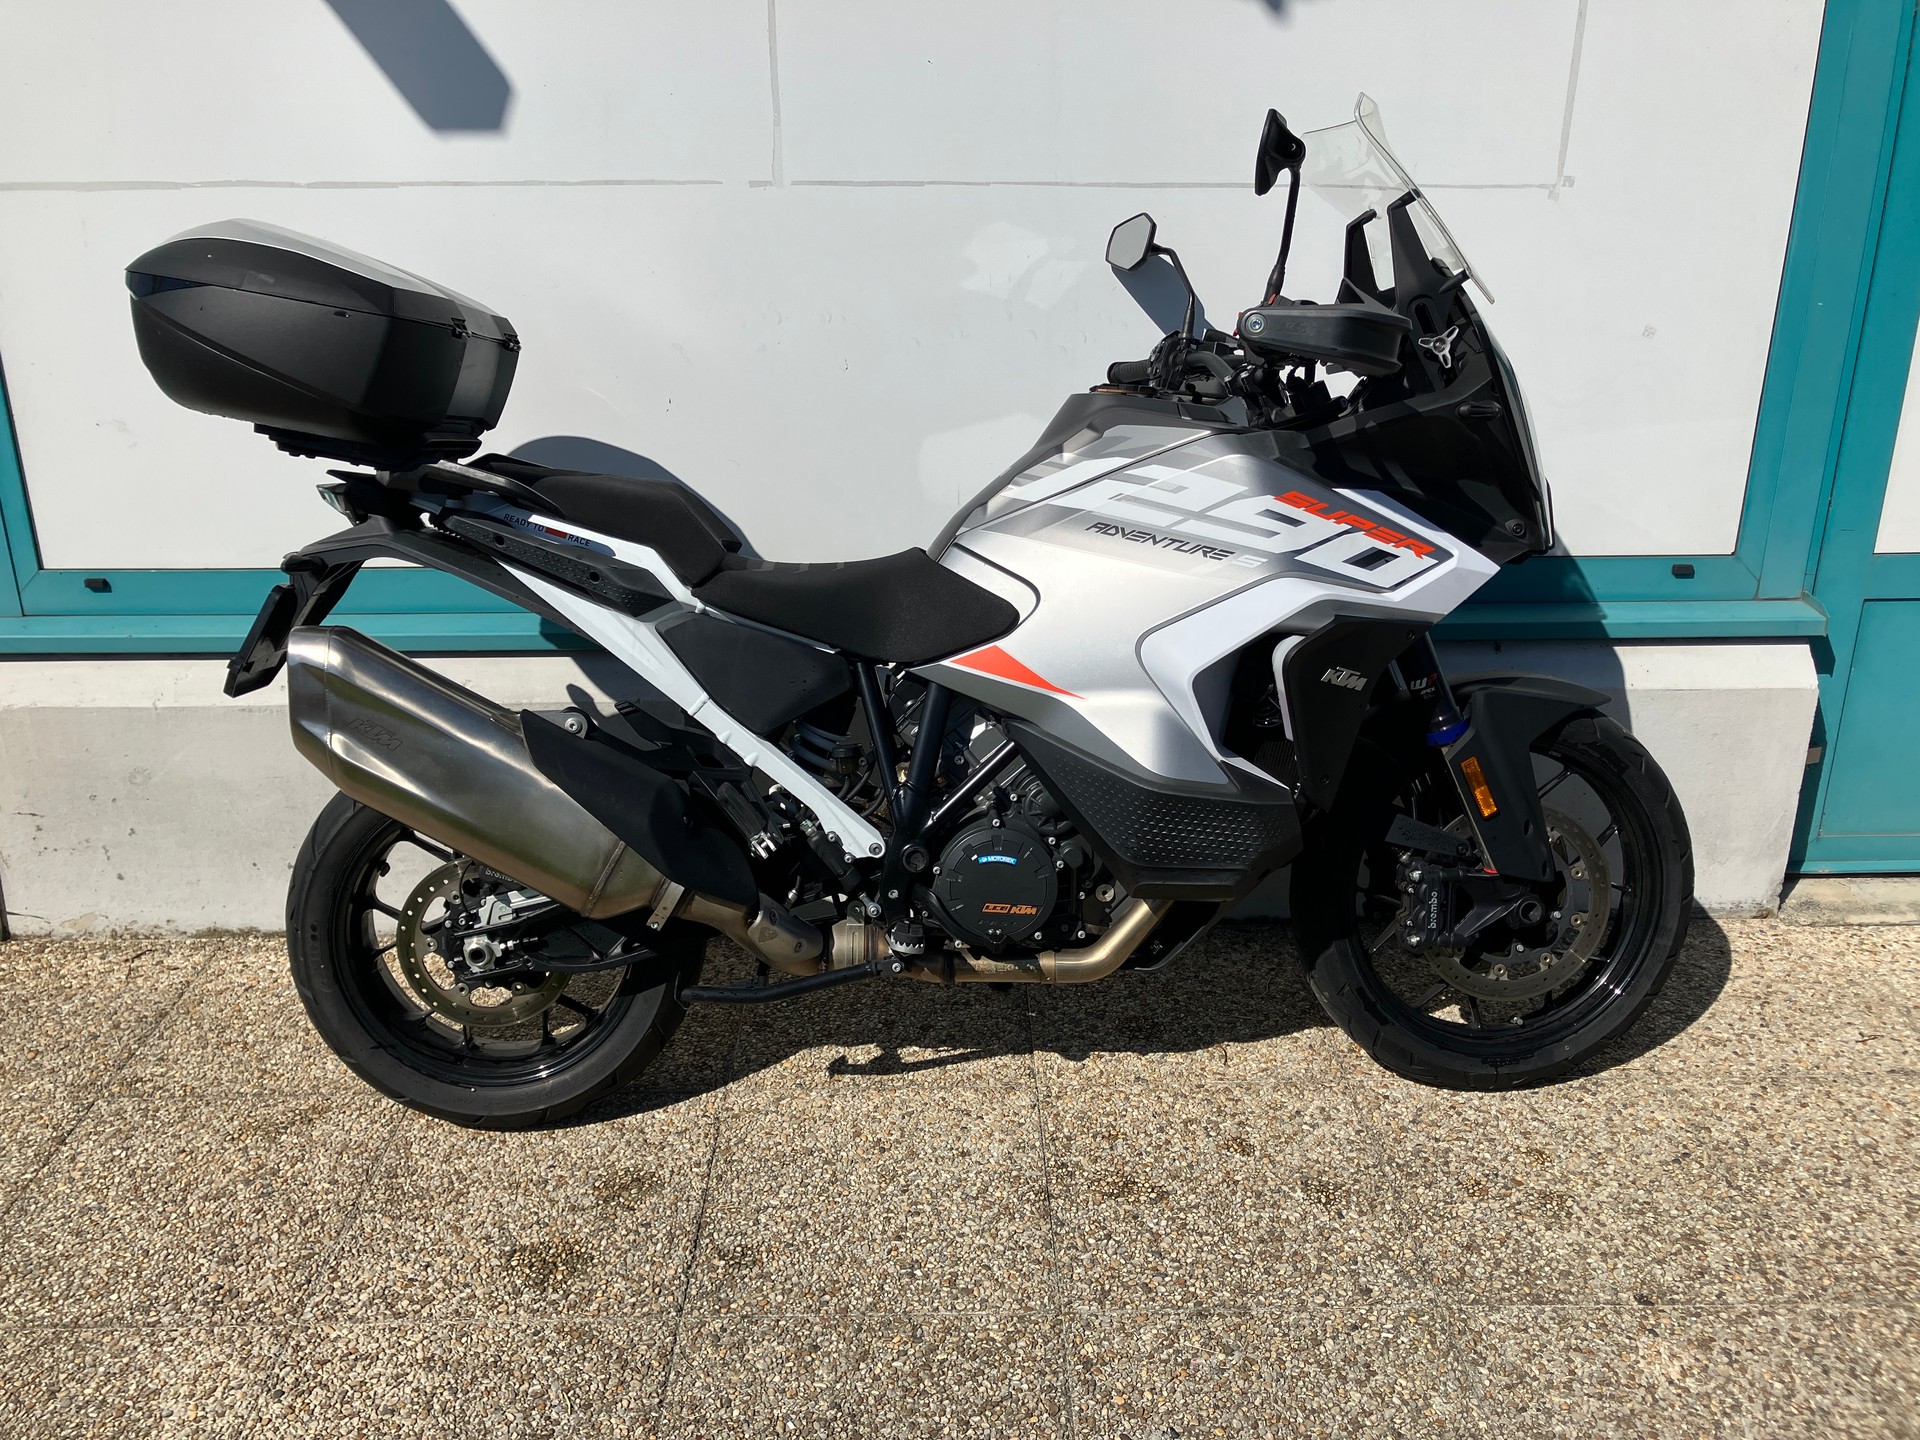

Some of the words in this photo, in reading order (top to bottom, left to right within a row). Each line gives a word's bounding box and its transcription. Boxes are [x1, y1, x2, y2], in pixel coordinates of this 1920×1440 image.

[503, 513, 532, 528] READY
[533, 522, 545, 532] TO
[567, 534, 591, 547] RACE
[1085, 522, 1236, 561] ADVENTURE
[1273, 491, 1435, 559] SUPER
[1320, 666, 1368, 691] KTM
[1410, 673, 1438, 690] WP
[347, 717, 404, 751] KTM
[988, 855, 1016, 865] MOTOREX
[1010, 904, 1038, 915] KTM
[1427, 890, 1438, 929] brembo
